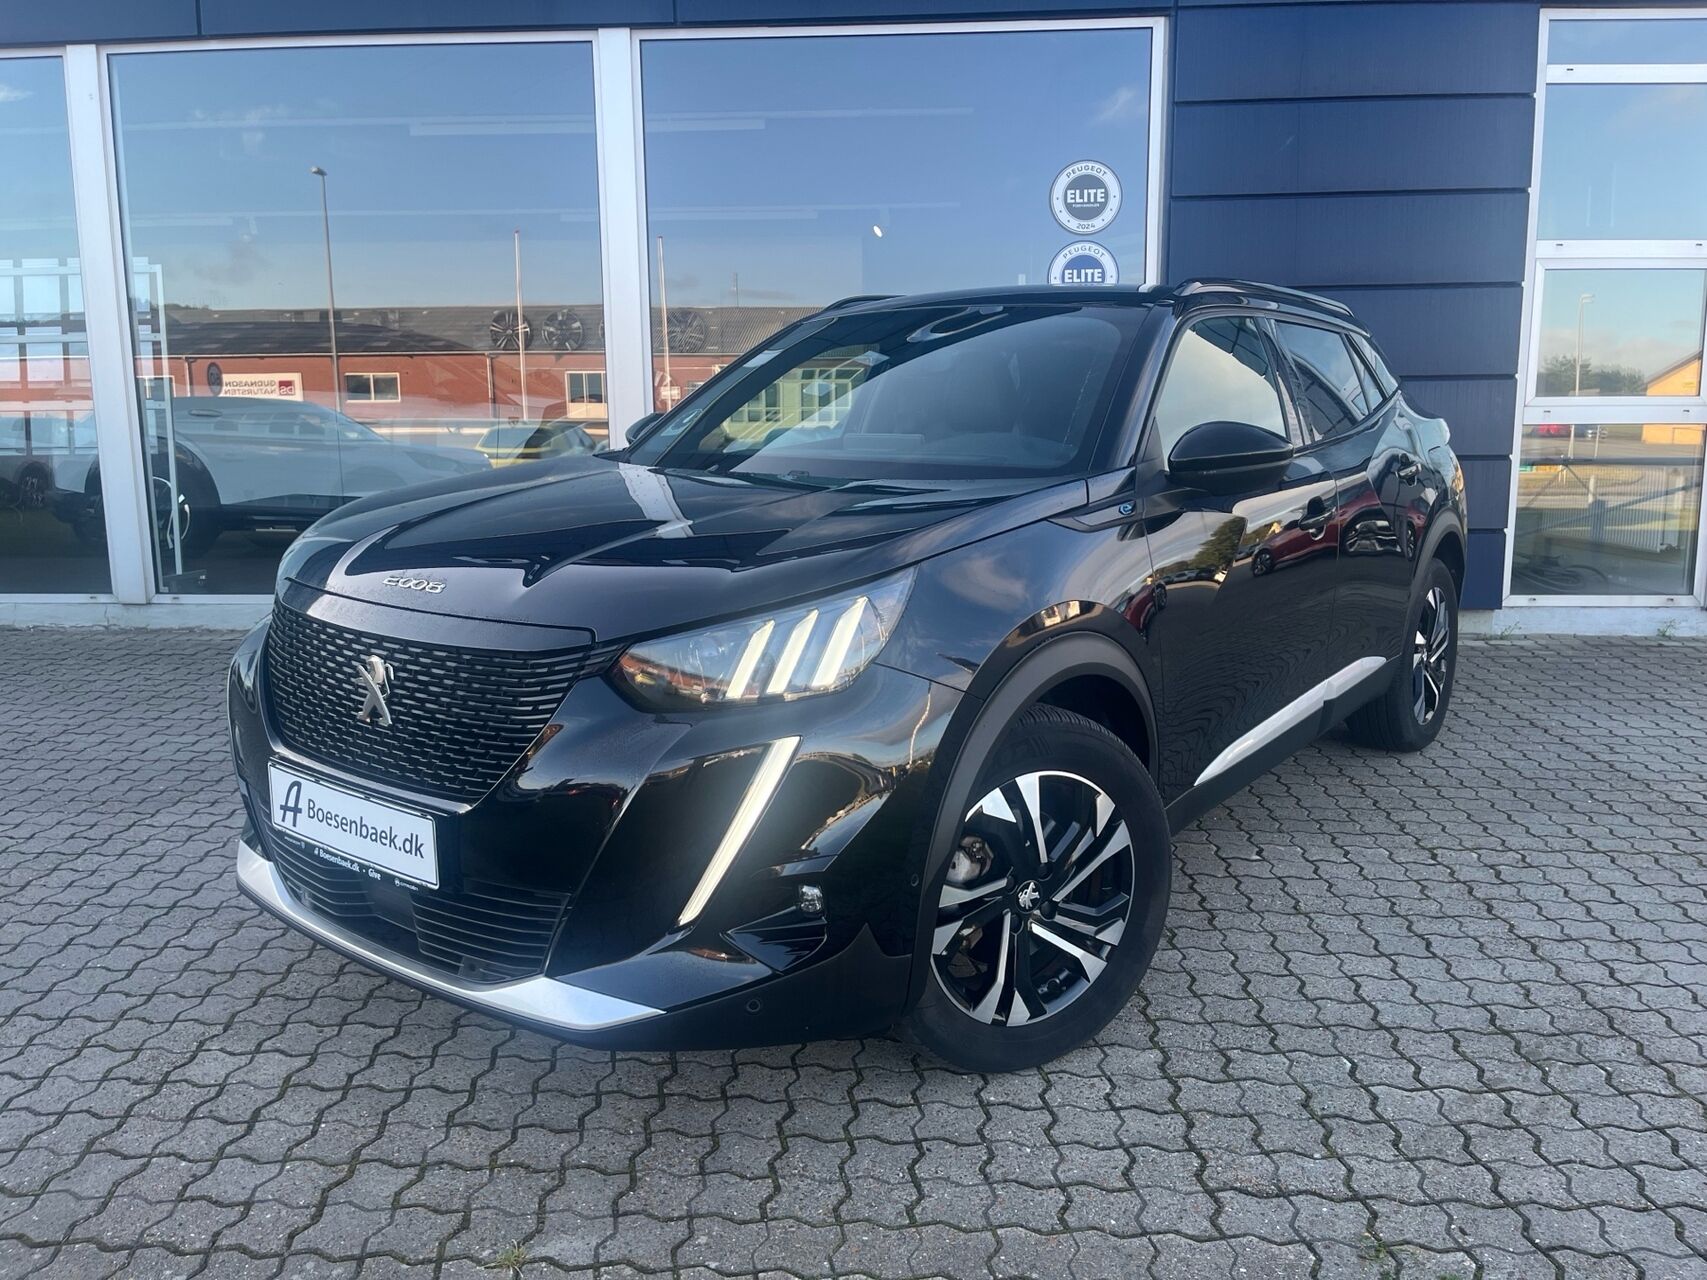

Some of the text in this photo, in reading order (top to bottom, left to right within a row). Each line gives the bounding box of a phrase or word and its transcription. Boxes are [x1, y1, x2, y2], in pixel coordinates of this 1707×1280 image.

[1065, 164, 1107, 179] PEUGEOT
[1066, 188, 1106, 204] ELITE
[1062, 245, 1105, 260] PEUGEOT
[1064, 268, 1103, 283] ELITE
[307, 798, 425, 859] Boesenbaek.dk
[319, 849, 360, 873] Boesenbaek.dk
[368, 868, 381, 881] Give
